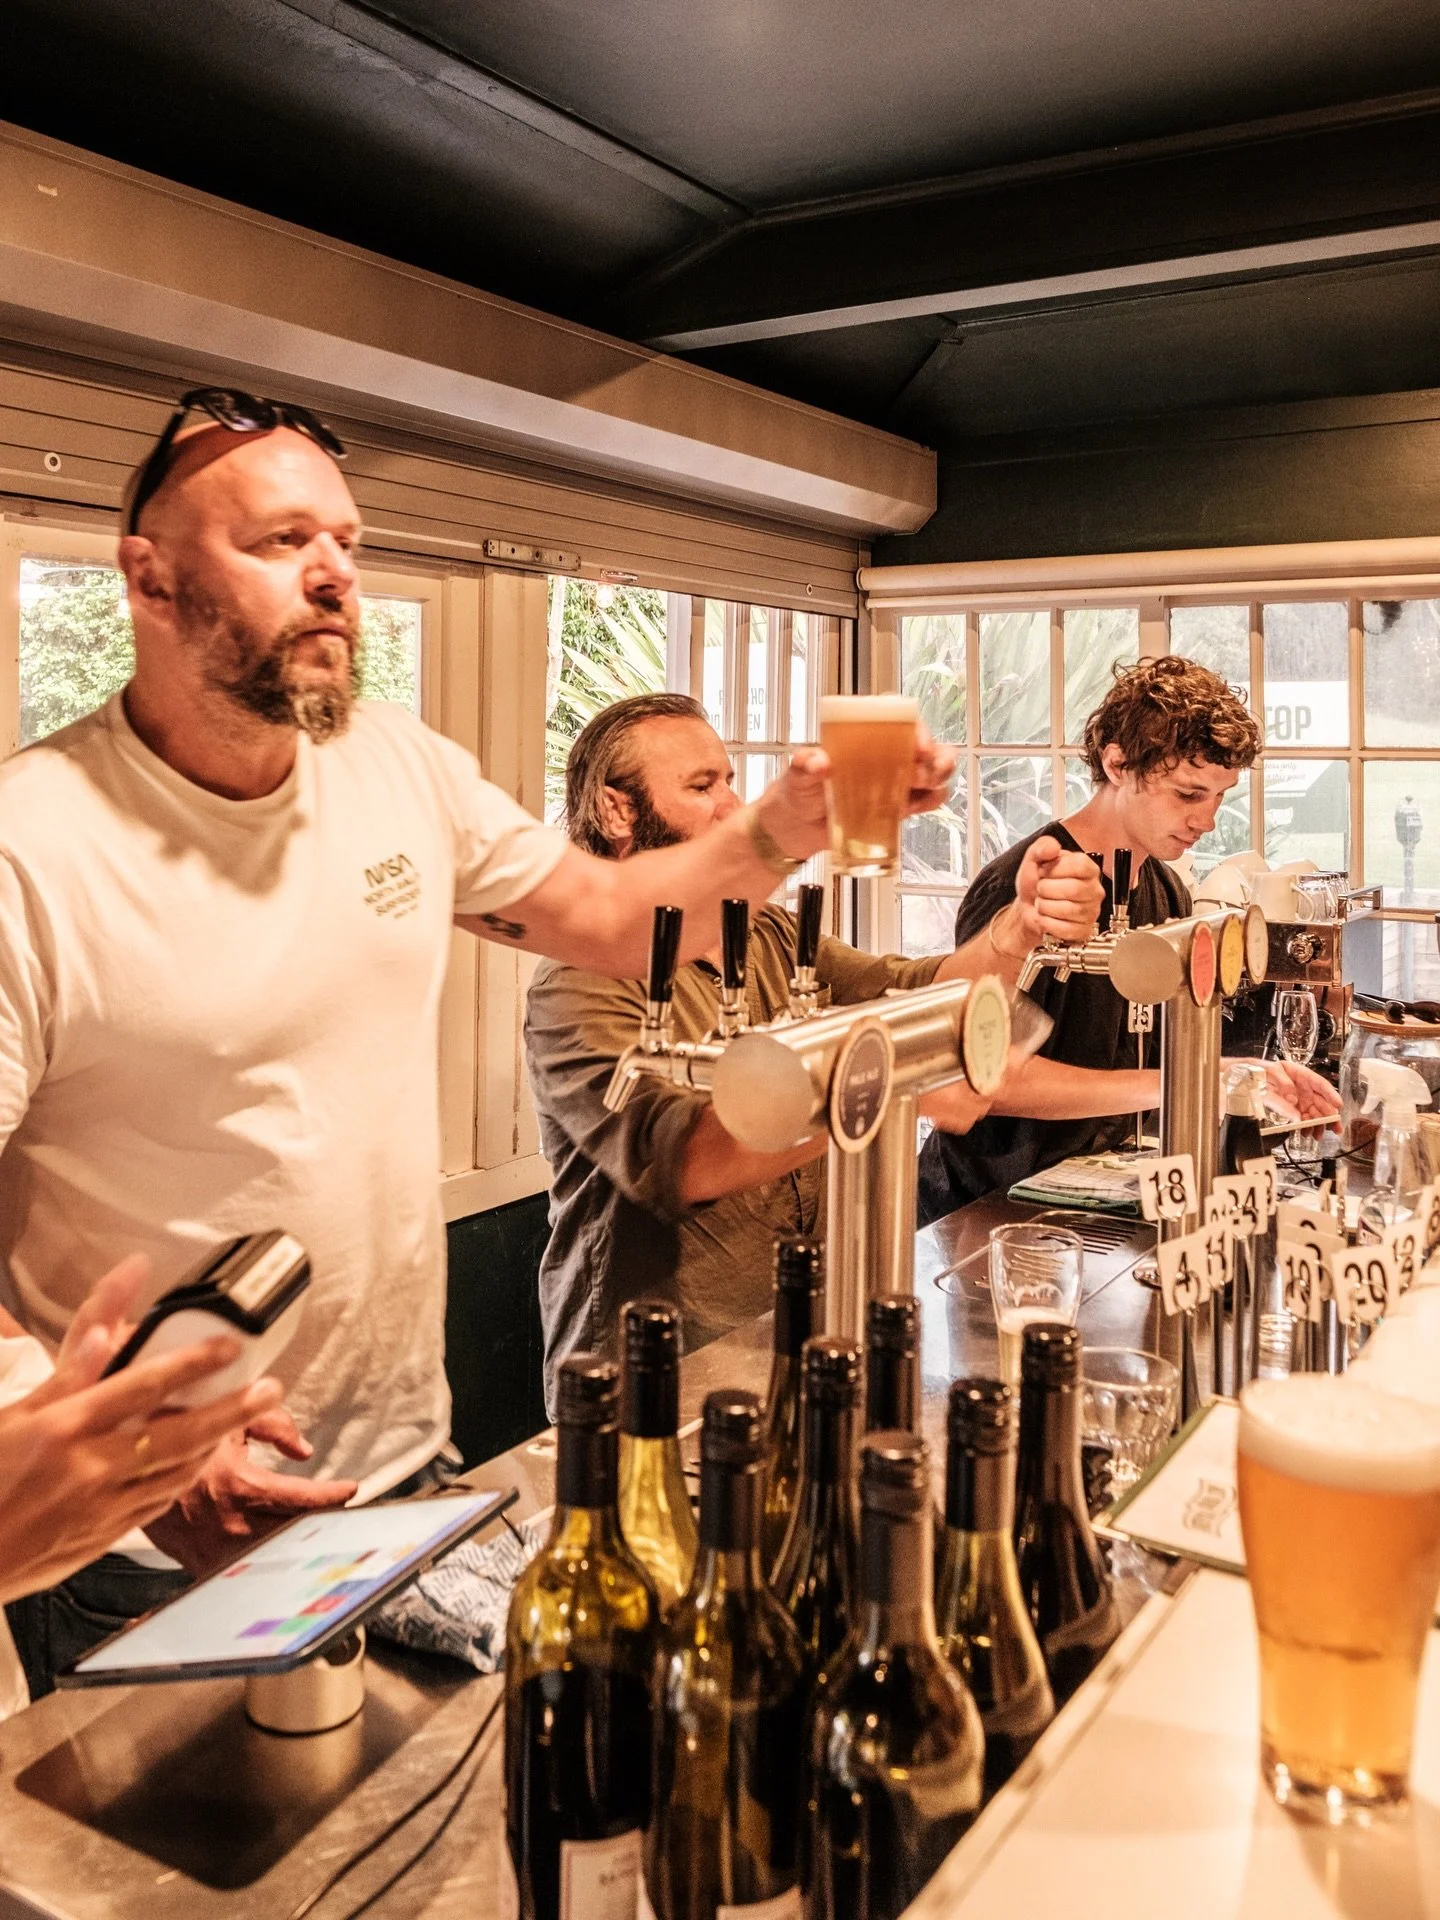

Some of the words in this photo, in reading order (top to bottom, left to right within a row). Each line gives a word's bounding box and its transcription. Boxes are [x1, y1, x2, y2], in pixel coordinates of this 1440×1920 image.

[1132, 1003, 1149, 1026] 15
[1149, 1168, 1186, 1206] 18
[1344, 1259, 1388, 1304] 20
